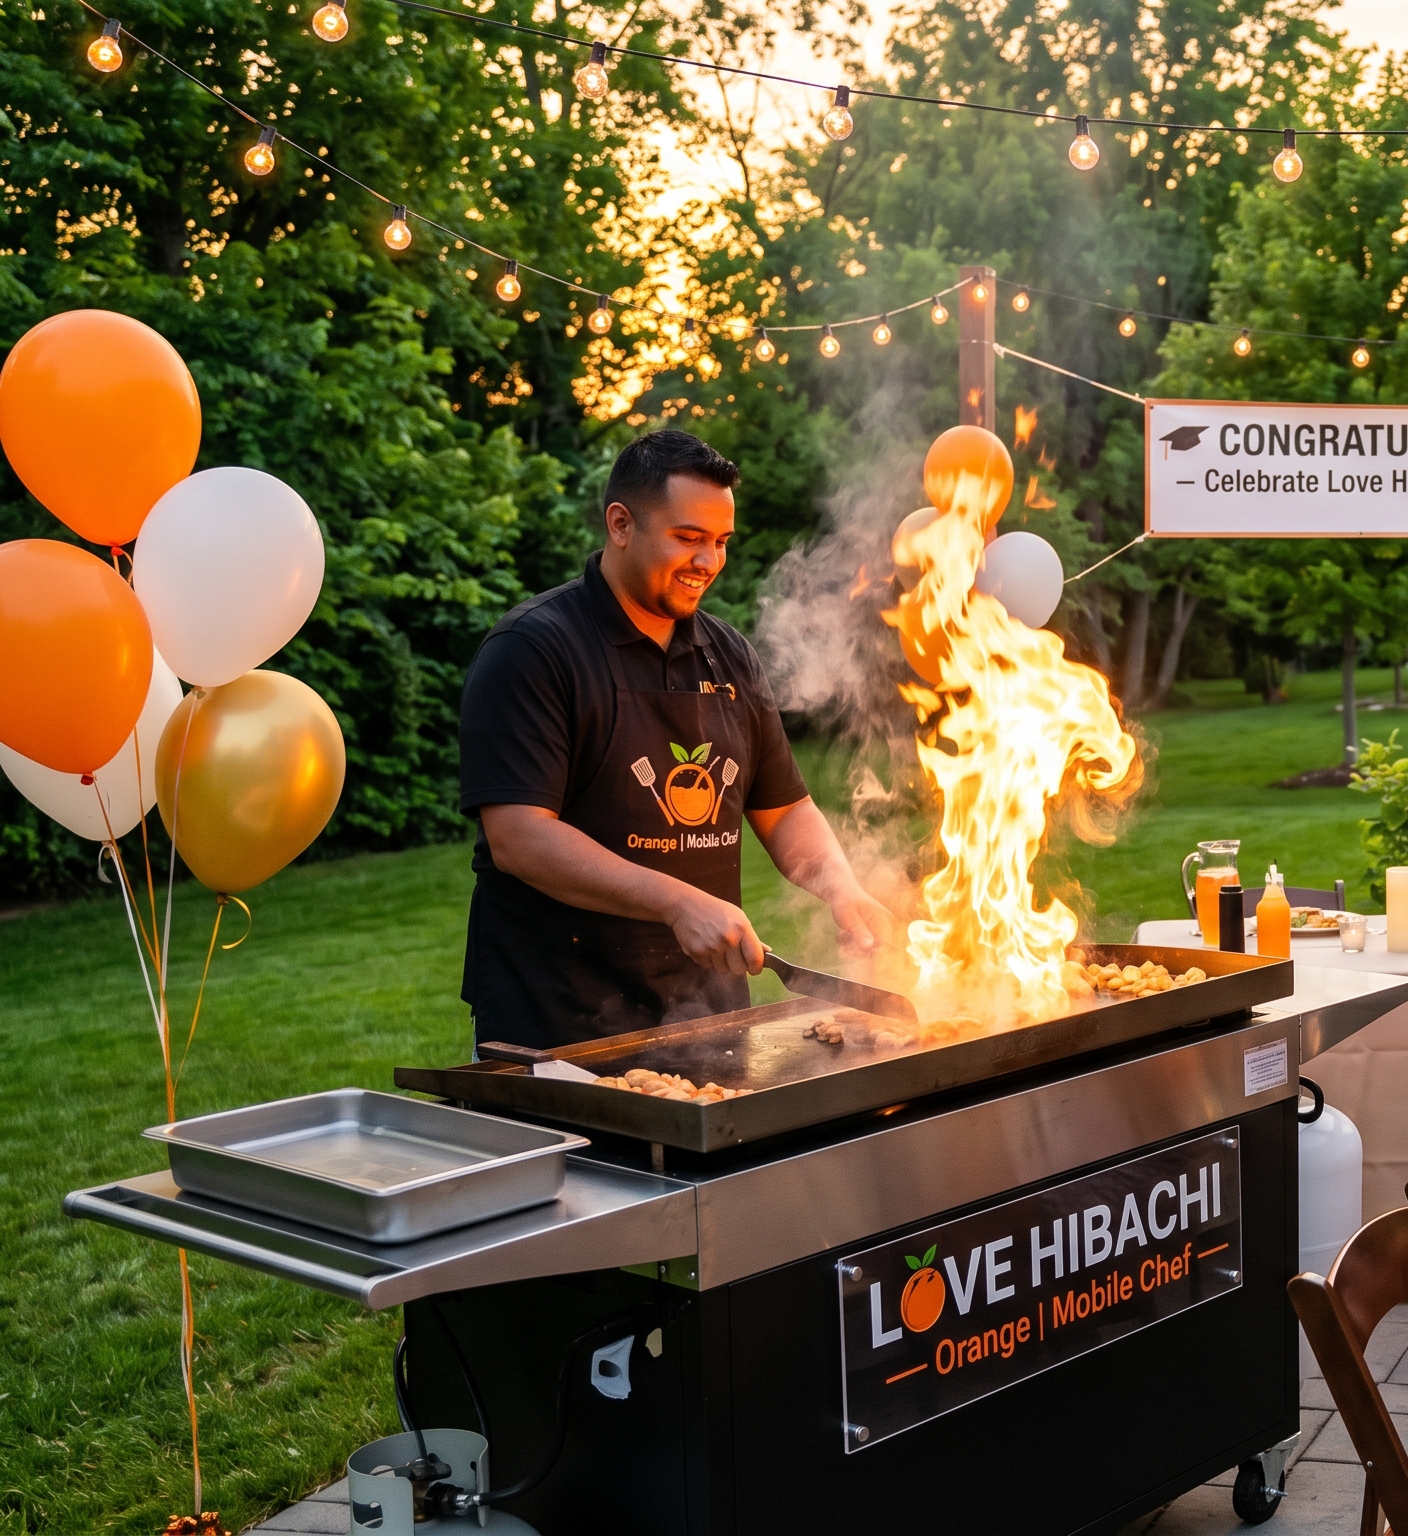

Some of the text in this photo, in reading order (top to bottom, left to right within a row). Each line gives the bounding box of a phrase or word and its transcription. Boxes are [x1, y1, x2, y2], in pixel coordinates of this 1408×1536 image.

[1204, 468, 1319, 493] Celebrate
[1328, 469, 1383, 493] Love
[627, 833, 677, 853] Orange
[1030, 1162, 1222, 1288] HIBACHI
[935, 1315, 1031, 1375] Orange
[1052, 1270, 1133, 1329] Mobile
[1139, 1242, 1193, 1293] Chef
